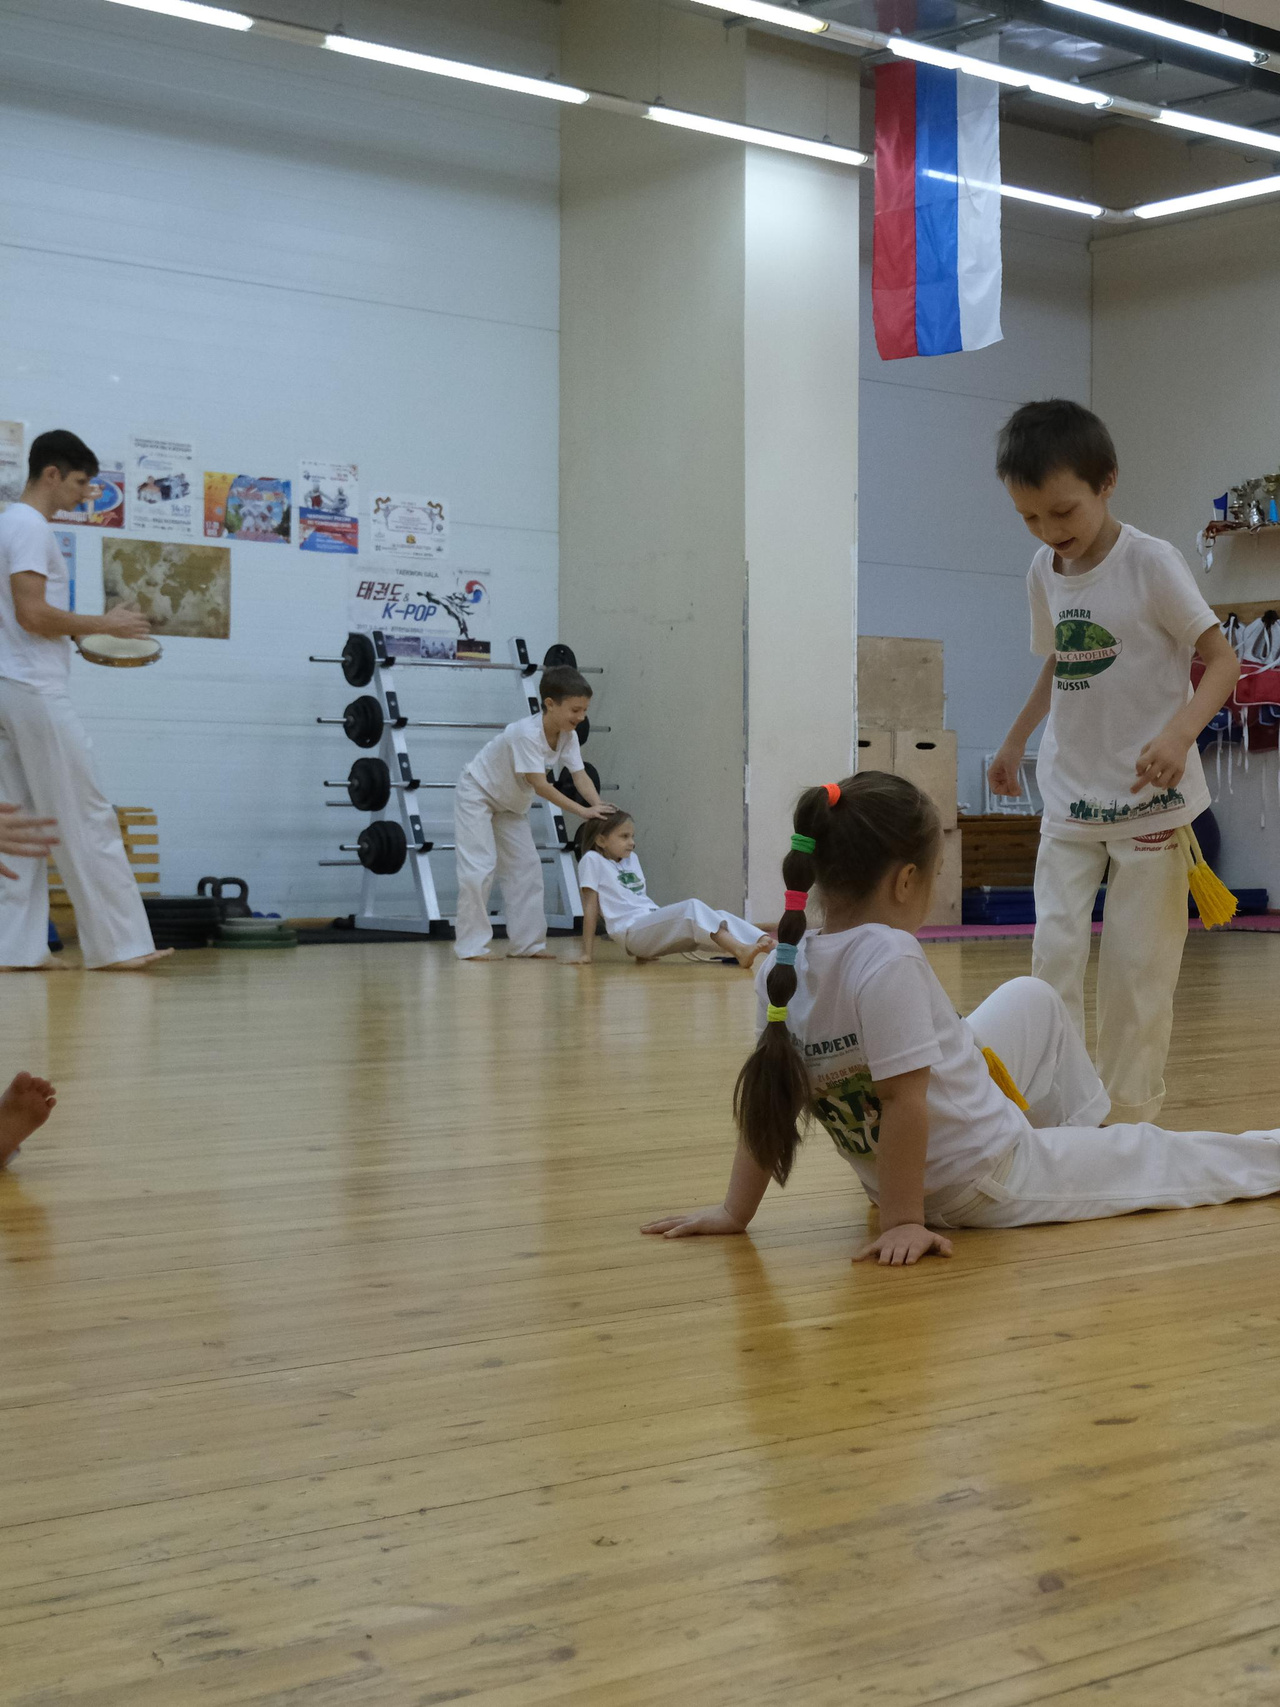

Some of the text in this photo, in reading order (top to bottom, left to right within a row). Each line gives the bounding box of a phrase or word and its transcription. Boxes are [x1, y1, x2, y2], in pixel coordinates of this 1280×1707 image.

[356, 581, 404, 602] 태권도
[382, 602, 437, 622] K-POP
[1059, 608, 1091, 620] SAMARA
